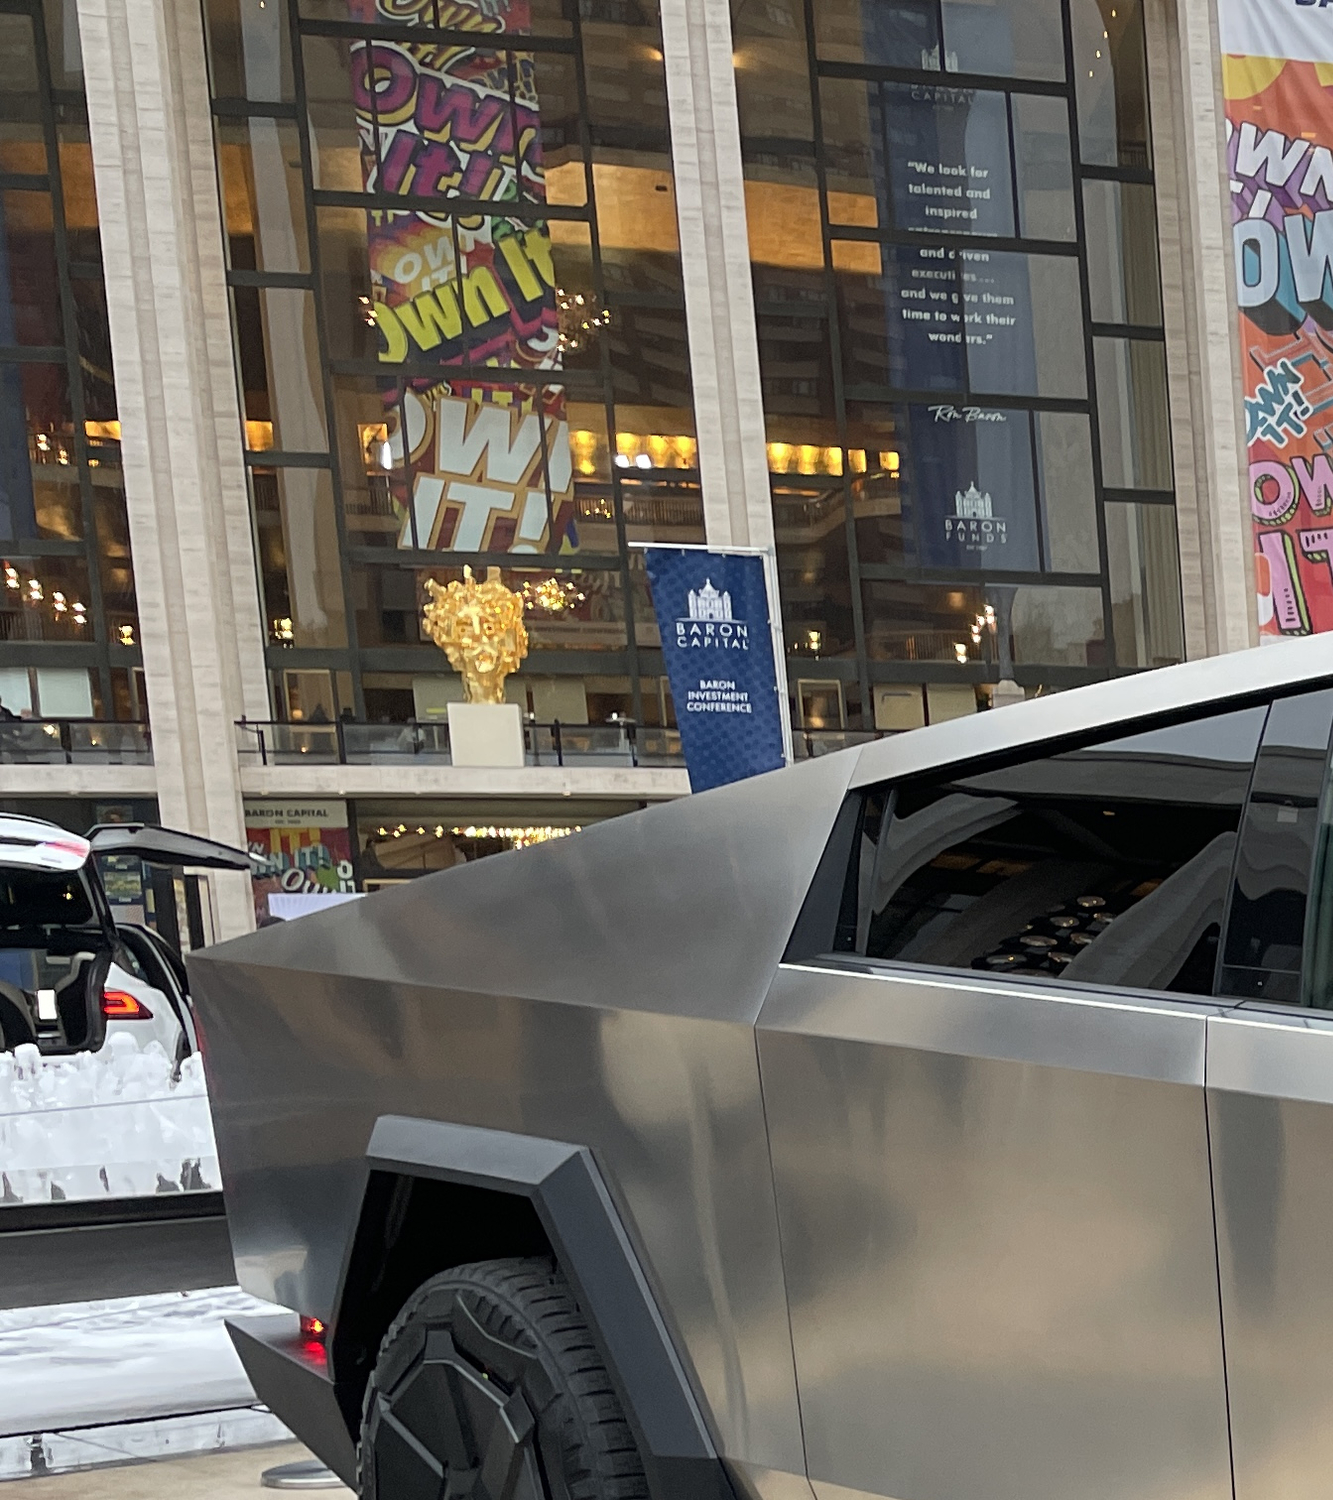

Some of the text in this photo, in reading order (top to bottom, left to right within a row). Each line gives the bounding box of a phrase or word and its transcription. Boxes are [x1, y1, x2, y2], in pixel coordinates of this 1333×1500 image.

[910, 91, 975, 105] CAPITAL
[938, 163, 966, 177] look
[970, 165, 989, 178] for
[908, 183, 991, 200] talented and
[925, 205, 978, 220] inspired
[920, 248, 945, 260] and
[901, 287, 1014, 305] and we gve them
[902, 308, 931, 321] time
[934, 310, 947, 322] to
[986, 313, 1016, 326] their
[402, 475, 550, 554] IT!
[944, 519, 1006, 533] BARON
[945, 531, 1007, 544] FUNDS
[675, 622, 748, 637] BARON
[676, 636, 749, 650] CAPITAL
[699, 679, 736, 691] BARON
[687, 690, 749, 702] INVESTMENT
[686, 701, 752, 713] CONFERENCE
[286, 809, 329, 817] CAPITAL
